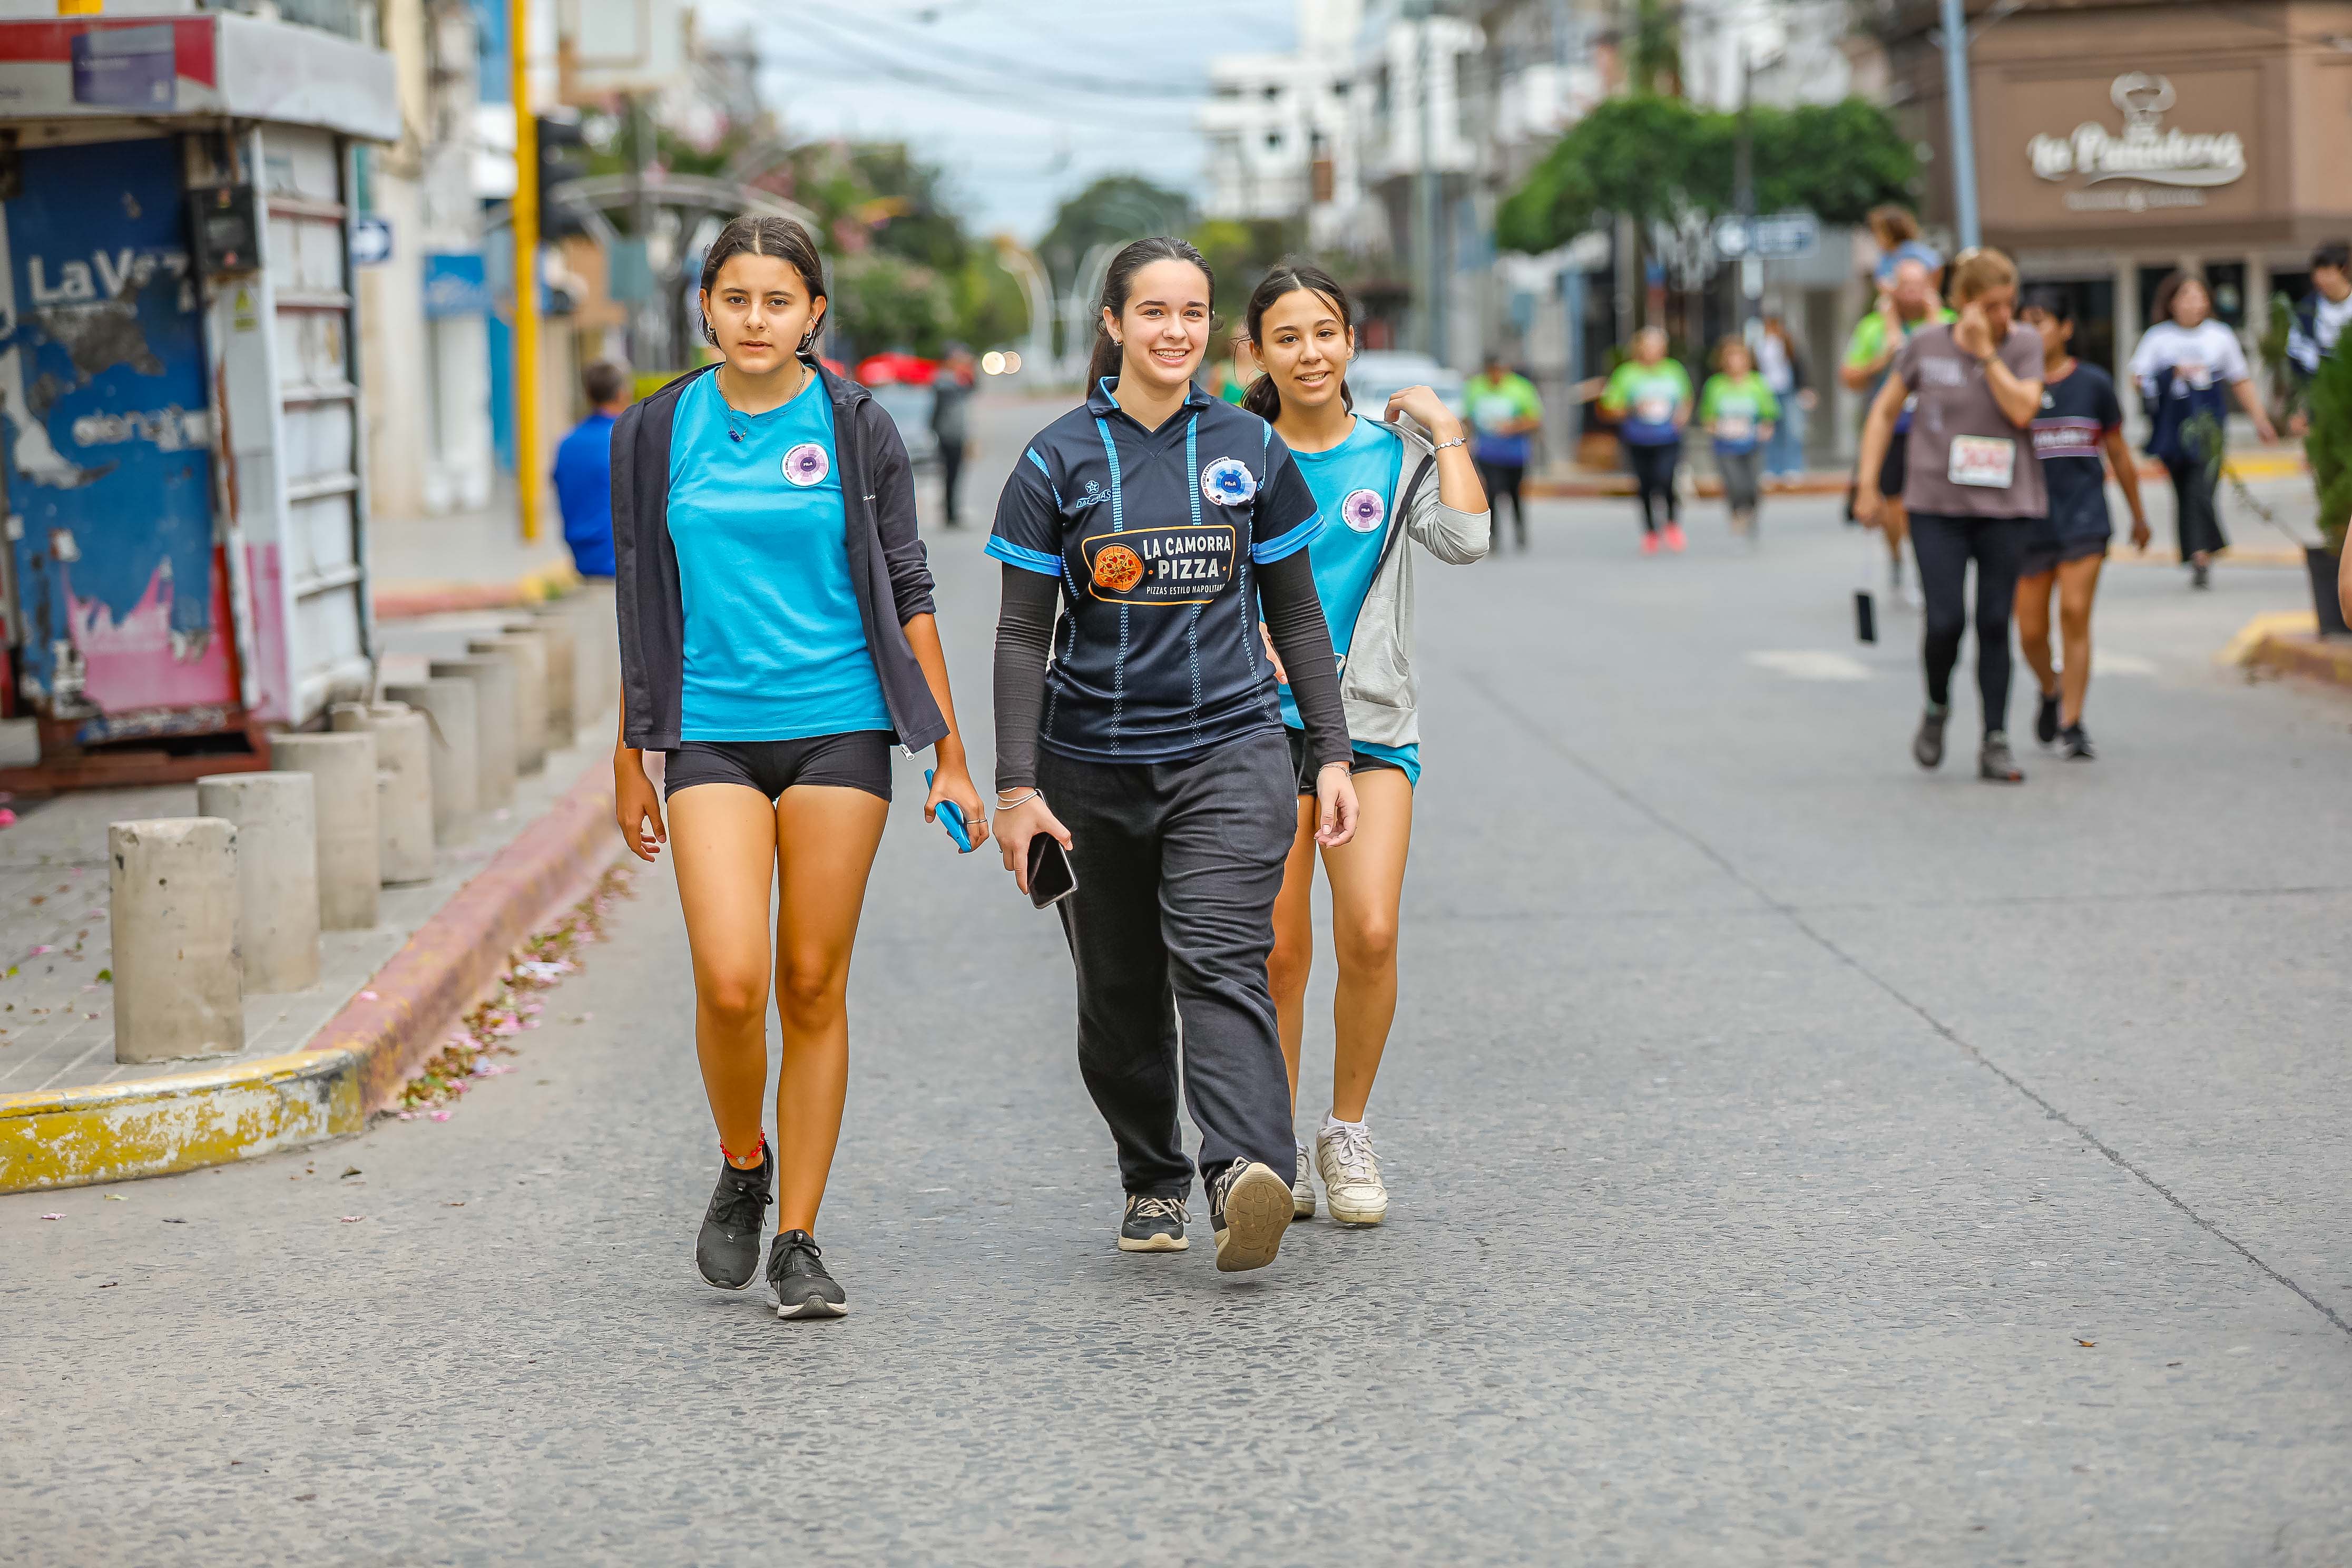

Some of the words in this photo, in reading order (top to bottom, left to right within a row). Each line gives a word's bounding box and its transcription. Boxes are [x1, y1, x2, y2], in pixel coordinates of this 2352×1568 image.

[1210, 495, 1221, 504] VILLE
[1143, 538, 1161, 560] LA
[1165, 535, 1231, 556] CAMORRA
[1159, 558, 1219, 580] PIZZA
[1146, 586, 1167, 595] PIZZAS
[1170, 585, 1190, 595] ESTILO
